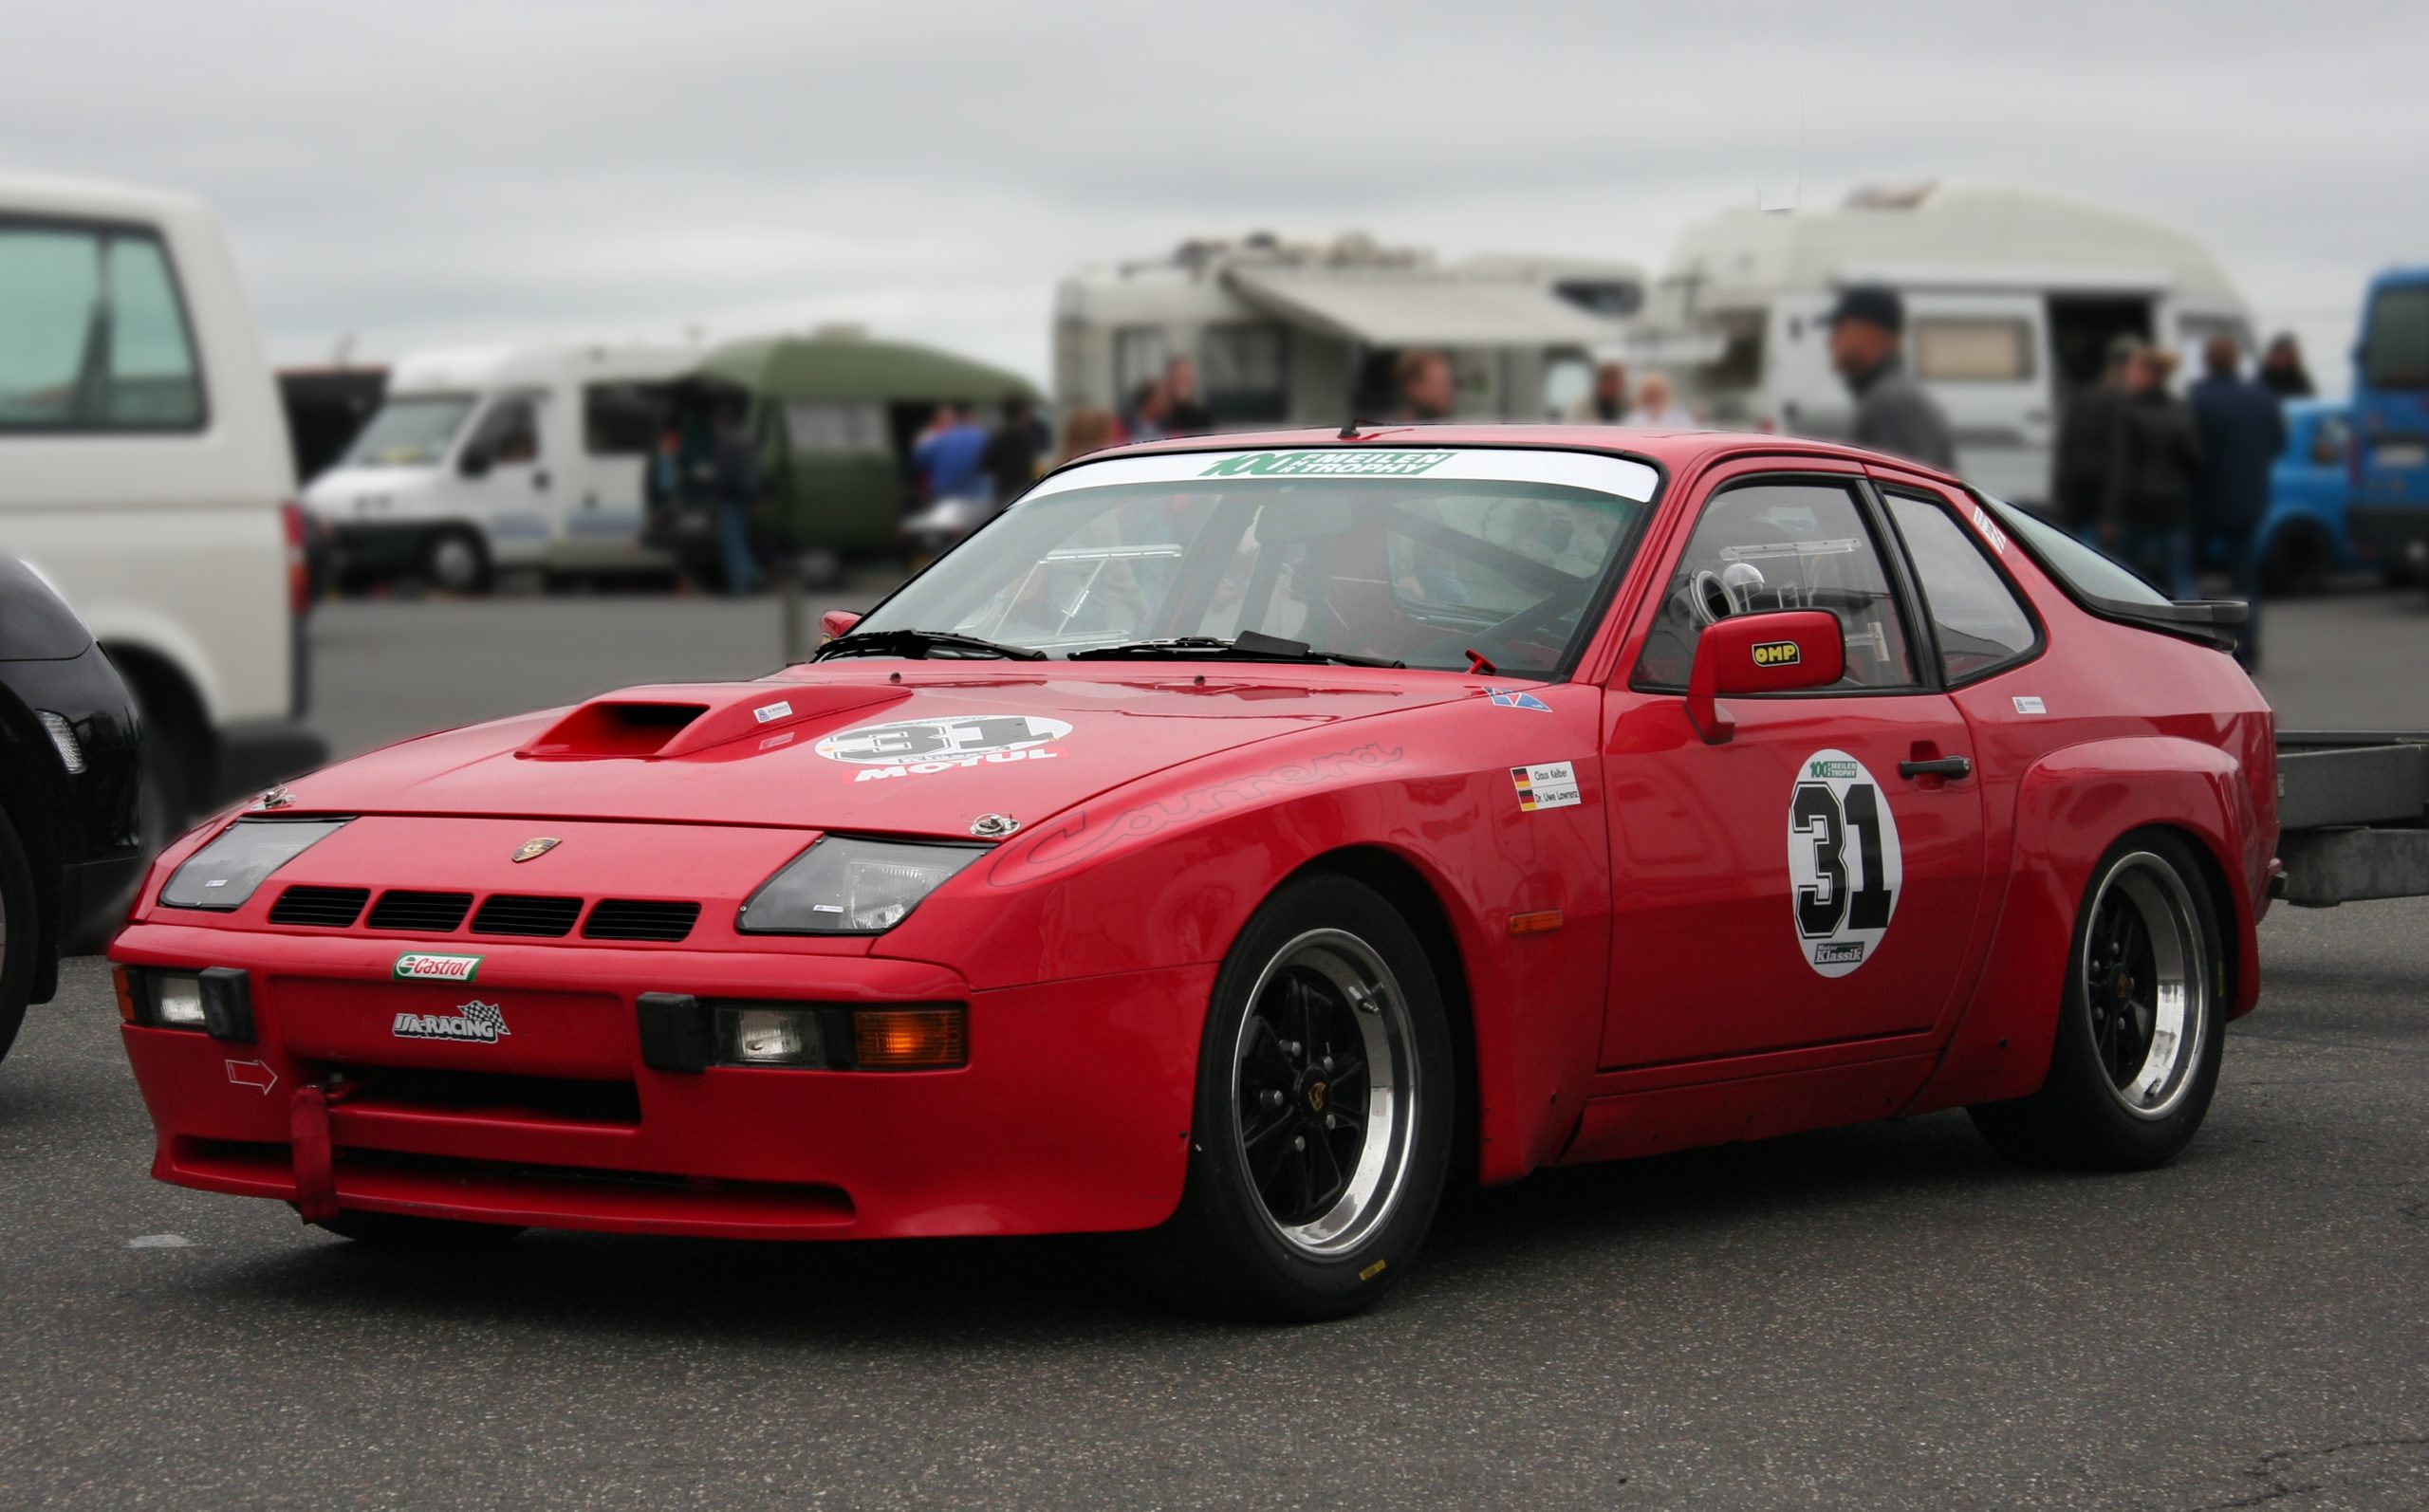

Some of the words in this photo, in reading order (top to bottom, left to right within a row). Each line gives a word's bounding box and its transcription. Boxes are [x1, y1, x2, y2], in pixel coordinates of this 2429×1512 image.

[1313, 453, 1448, 465] MEILEN
[1299, 463, 1429, 474] TROPHY
[1755, 645, 1796, 662] OMP
[829, 717, 1055, 760] 31
[854, 748, 1058, 782] MOTUL
[1810, 762, 1828, 778] 100
[1831, 762, 1857, 770] MEILEN
[1534, 770, 1549, 781] Claus
[1535, 793, 1545, 802] Dr.
[1544, 791, 1557, 802] Uwe
[988, 743, 1404, 888] Carrera
[1790, 782, 1892, 939] 31
[1815, 949, 1862, 963] Klassik
[414, 957, 471, 977] Castrol
